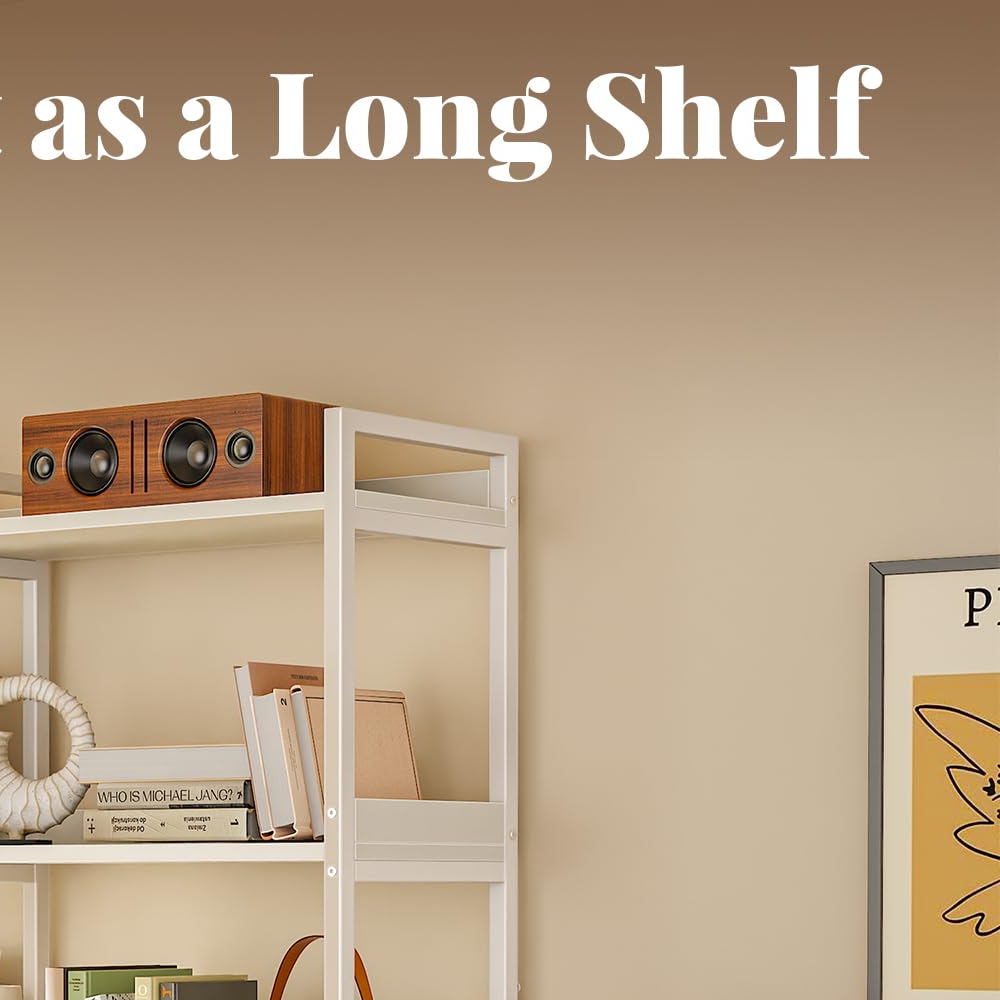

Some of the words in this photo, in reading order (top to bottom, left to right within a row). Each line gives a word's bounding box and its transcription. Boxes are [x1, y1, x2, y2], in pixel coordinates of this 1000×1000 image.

[964, 587, 1000, 627] P
[280, 697, 288, 706] 2
[98, 790, 127, 803] WHO
[129, 790, 140, 802] IS
[142, 789, 194, 802] MICHAEL
[195, 788, 233, 801] JANG?
